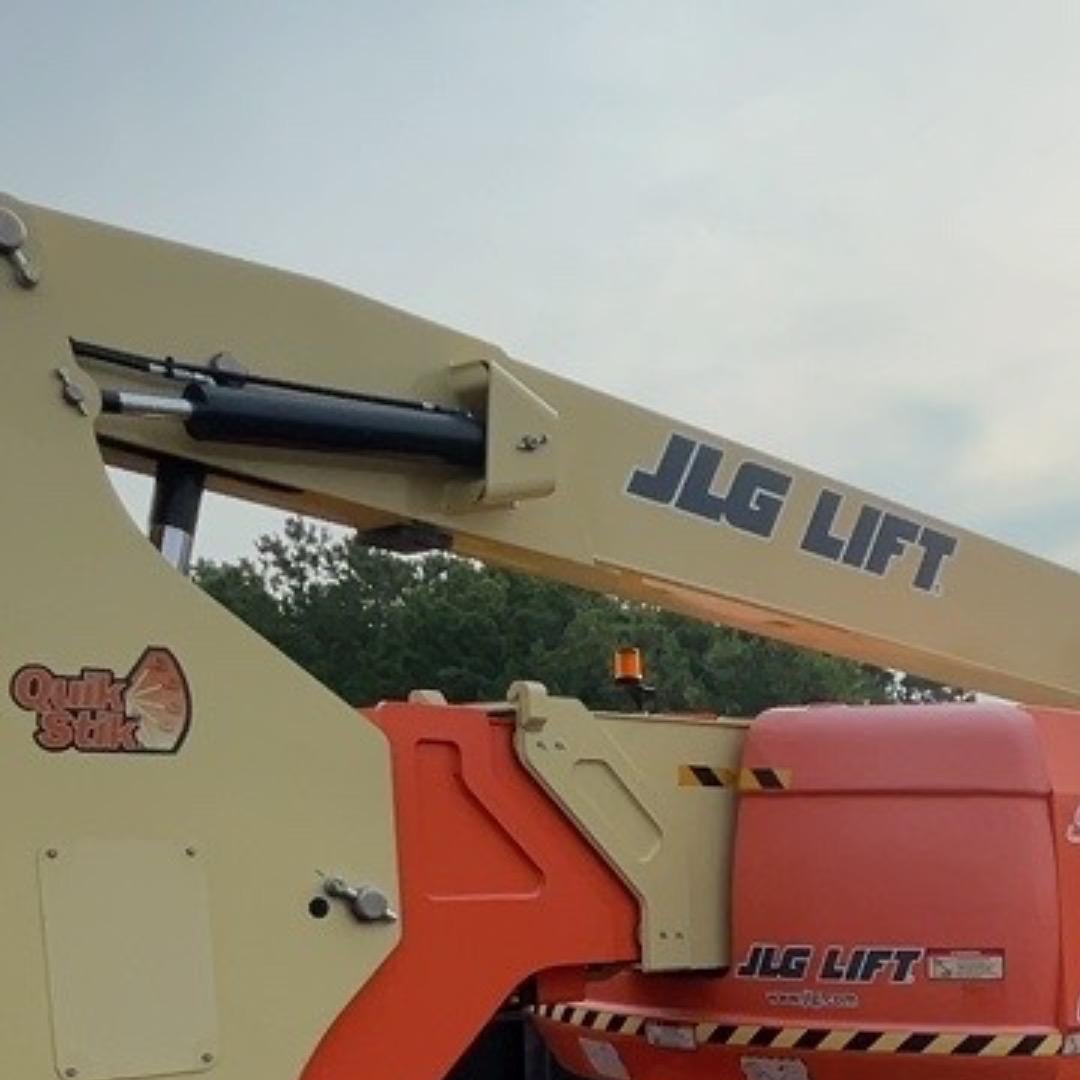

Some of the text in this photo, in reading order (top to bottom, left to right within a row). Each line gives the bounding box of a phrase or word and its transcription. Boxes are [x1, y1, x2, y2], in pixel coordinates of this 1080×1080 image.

[626, 432, 958, 594] JLG LIFT
[12, 666, 127, 711] Quik
[38, 709, 139, 750] Stik
[737, 944, 812, 980] JLG
[818, 945, 924, 984] LIFT
